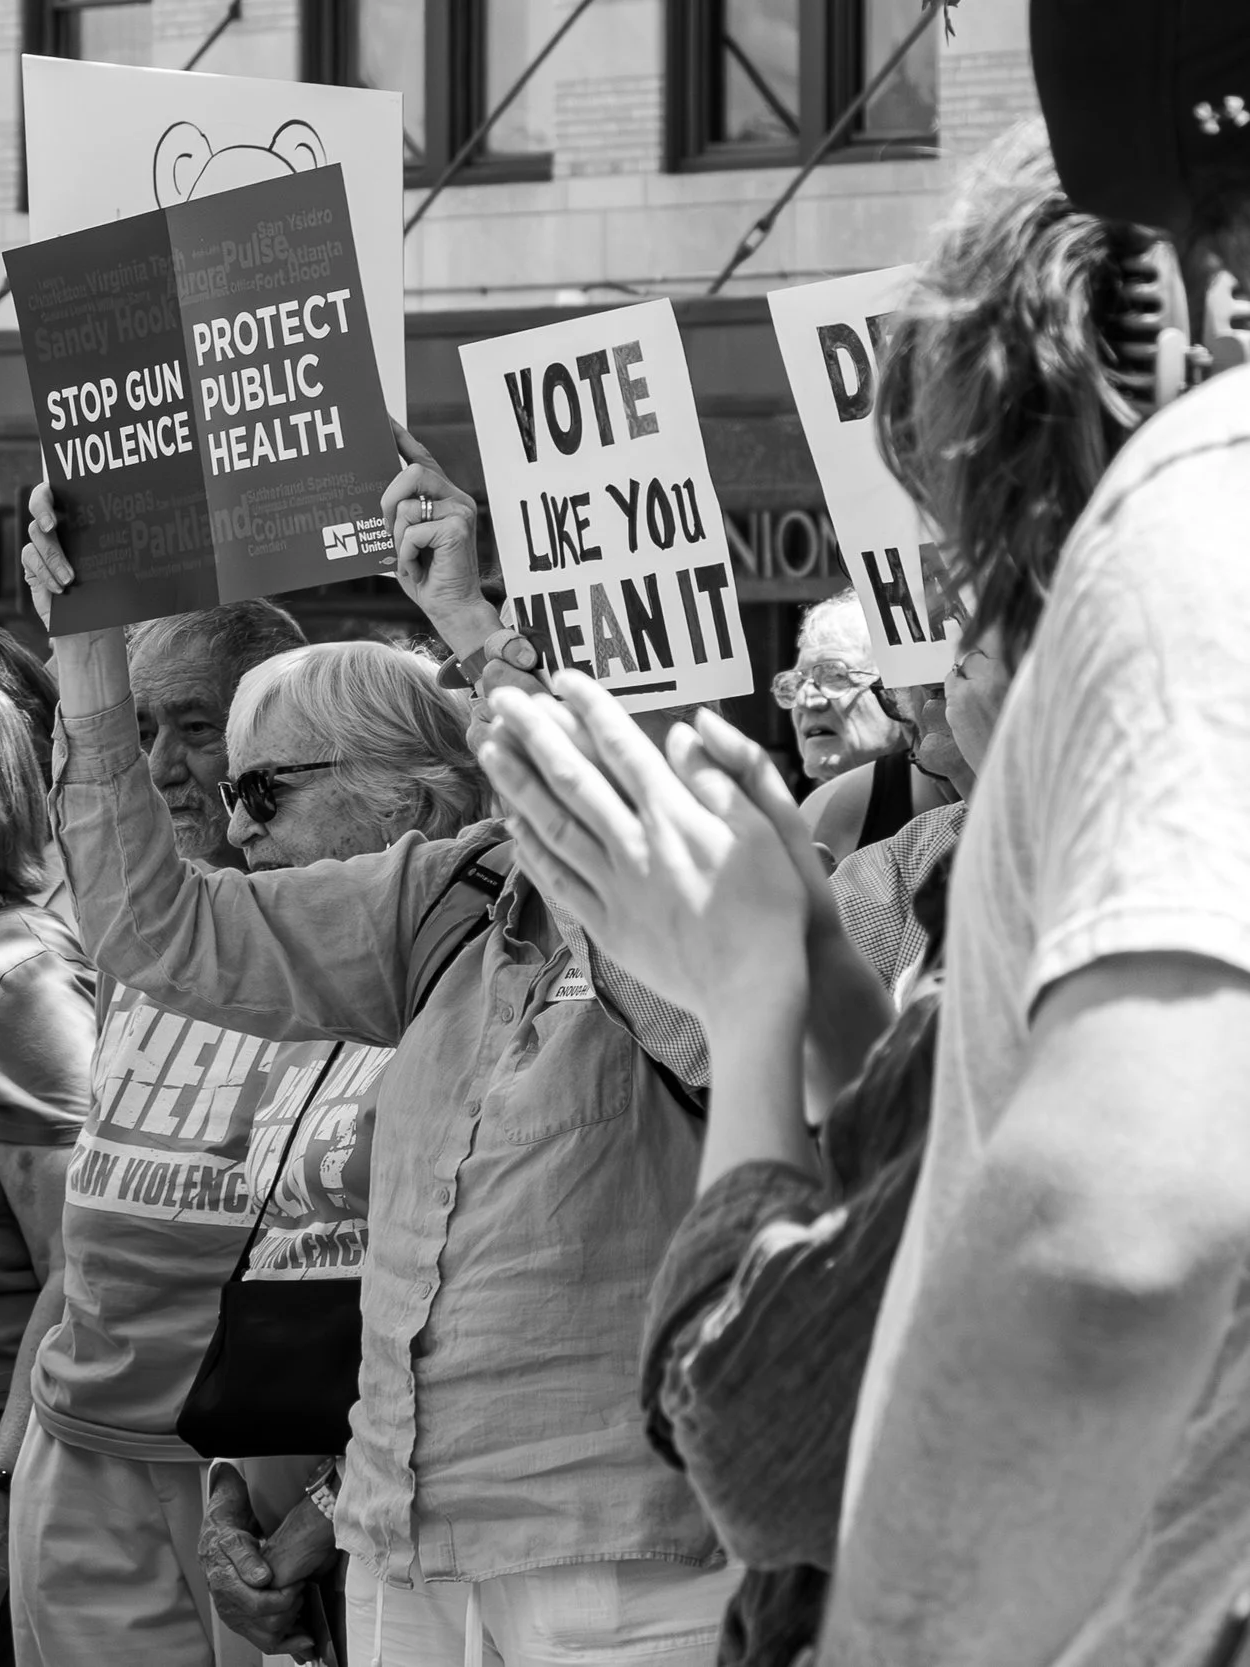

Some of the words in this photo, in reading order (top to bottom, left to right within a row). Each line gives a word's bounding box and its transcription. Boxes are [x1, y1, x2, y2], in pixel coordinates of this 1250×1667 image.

[221, 232, 290, 273] Pulse
[256, 220, 284, 239] San
[285, 207, 333, 231] Ysidro
[288, 240, 343, 264] Atlanta
[85, 258, 149, 295] Virginia
[148, 247, 186, 277] Teh
[255, 269, 285, 291] Fort
[288, 258, 331, 283] Hood
[35, 314, 109, 361] Sandy
[114, 294, 178, 343] Hook
[192, 288, 351, 367] PROTECT
[47, 377, 118, 430] STOP
[125, 360, 184, 411] GUN
[200, 354, 324, 421] PUBLIC
[504, 340, 660, 463] VOTE
[54, 412, 193, 480] VIOLENCE
[207, 406, 345, 475] HEALTH
[98, 489, 154, 521] Vegas
[130, 491, 252, 565] Parkland
[251, 502, 364, 543] Columbine
[520, 491, 602, 572] LIKE
[605, 477, 706, 553] YOU
[248, 540, 287, 557] Camden
[361, 538, 394, 554] United
[513, 573, 675, 680] MEAN
[676, 562, 734, 665] IT
[117, 1157, 255, 1215] VIOLENC
